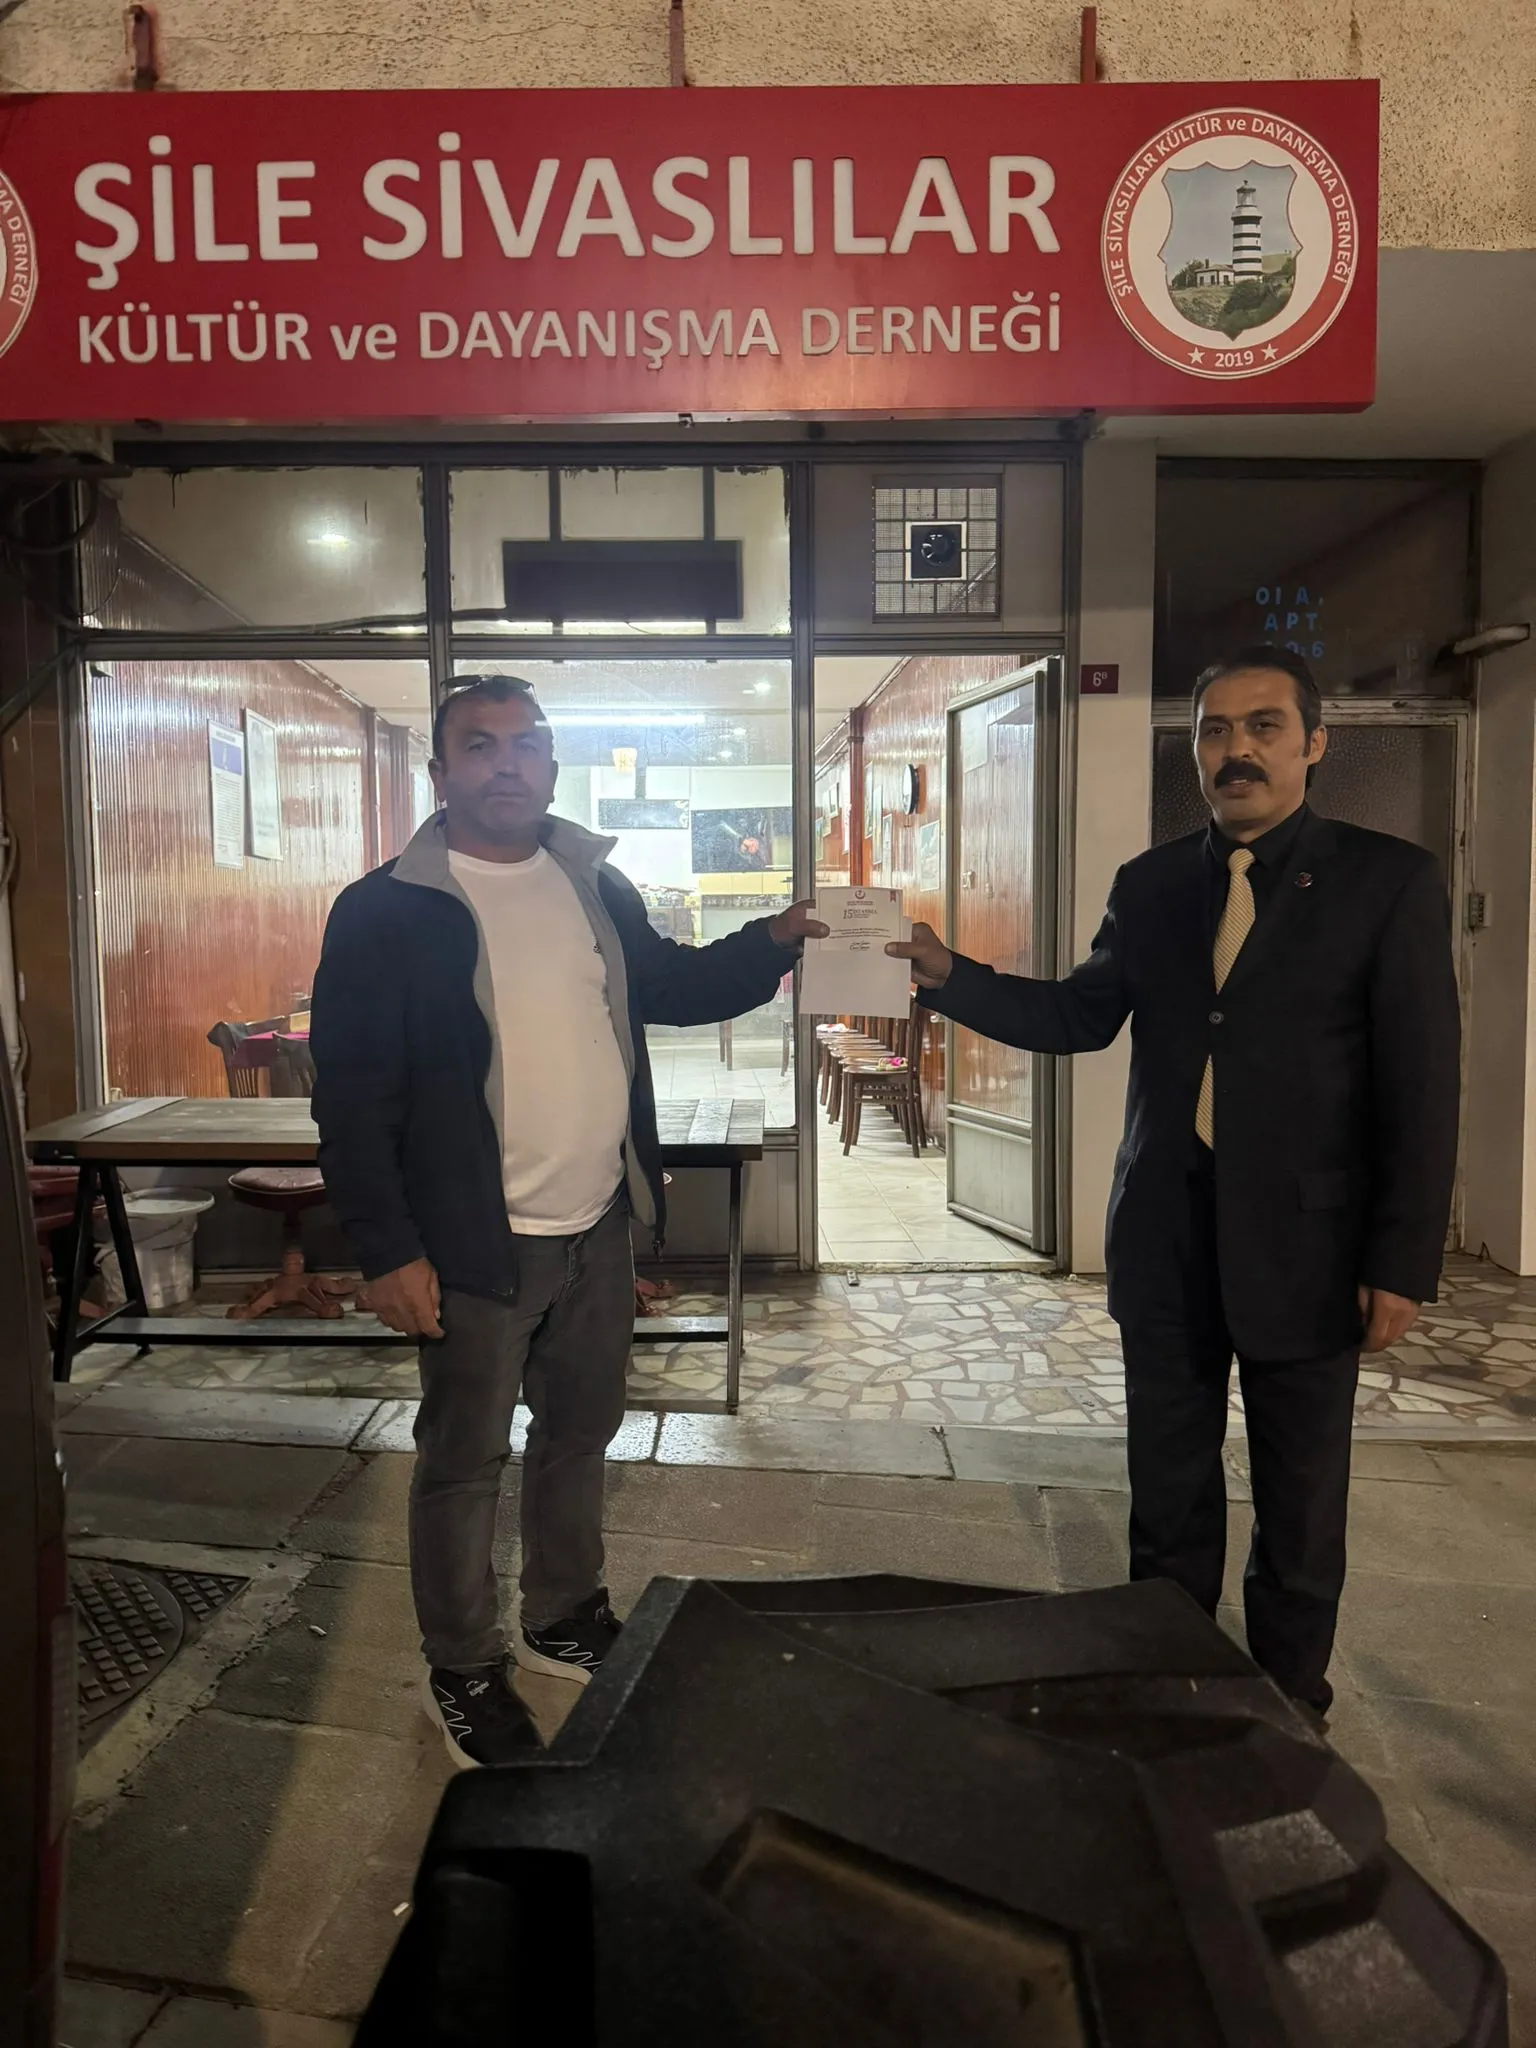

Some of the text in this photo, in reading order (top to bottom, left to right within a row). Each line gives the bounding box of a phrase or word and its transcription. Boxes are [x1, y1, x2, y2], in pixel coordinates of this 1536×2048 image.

[74, 131, 1061, 290] ŞİLE SİVASLILAR
[1106, 116, 1353, 297] ŞİLE SİVASLILAR KÜLTÜR ve DAYANIŞMA DERNEĞİ
[7, 215, 30, 307] DERNEĞİ
[79, 290, 1061, 371] KÜLTÜR ve DAYANIŞMA DERNEĞİ
[1214, 350, 1255, 368] 2019
